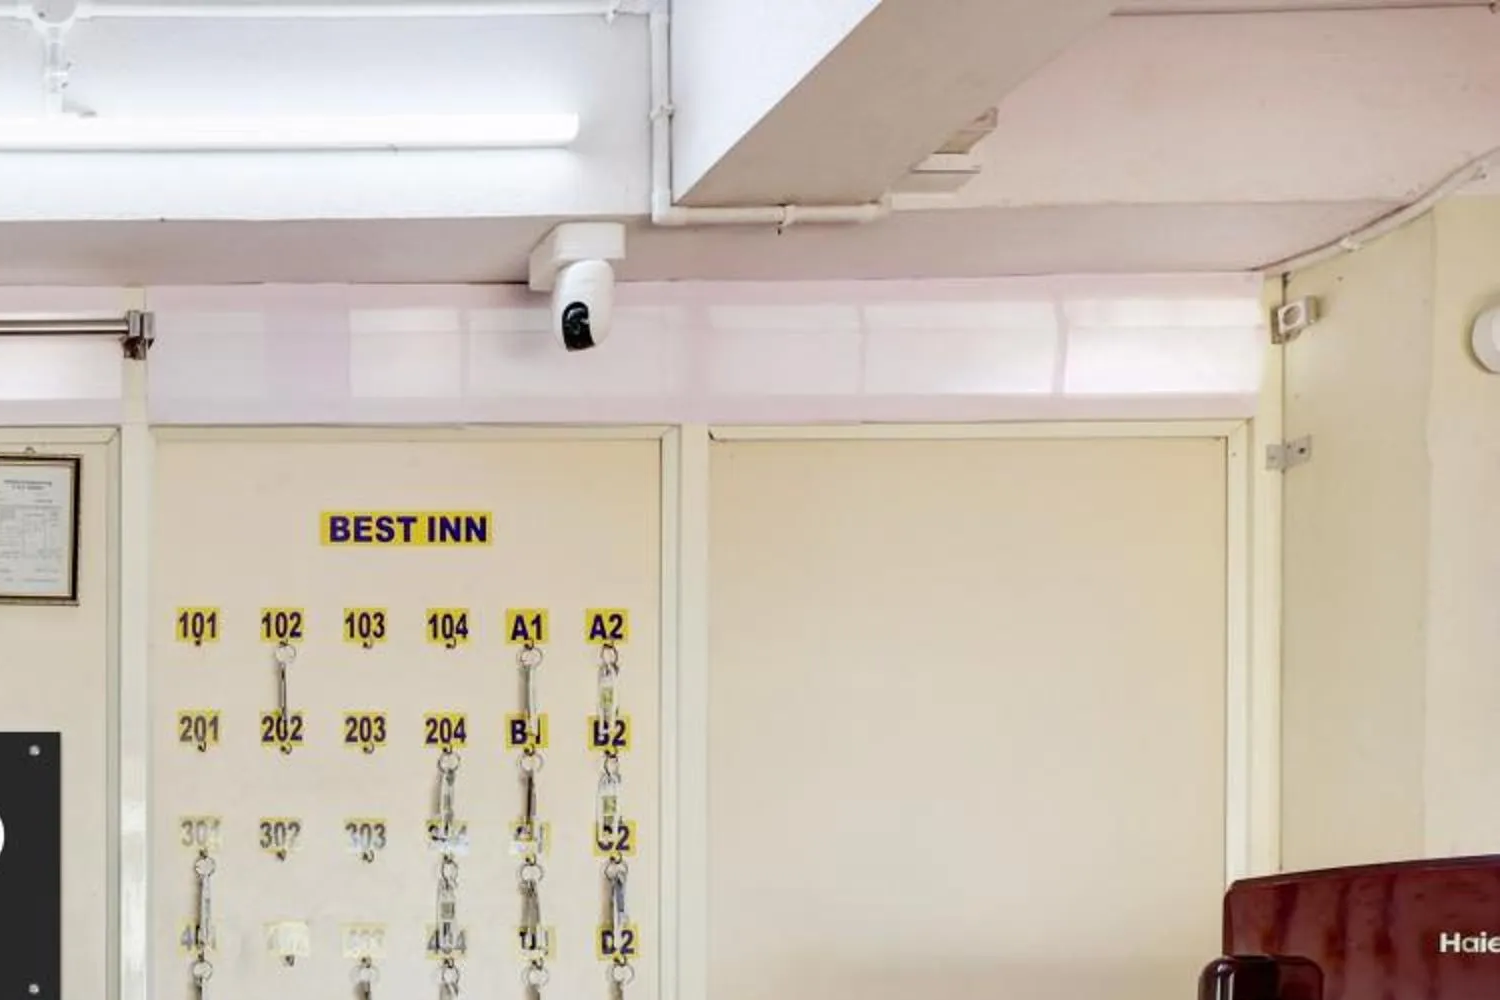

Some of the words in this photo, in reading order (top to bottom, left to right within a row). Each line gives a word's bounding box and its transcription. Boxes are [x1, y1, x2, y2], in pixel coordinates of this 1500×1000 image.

[329, 515, 417, 542] BEST
[427, 516, 487, 542] INN
[179, 612, 217, 638] 101
[261, 612, 302, 638] 102
[345, 612, 386, 638] 103
[428, 613, 469, 639] 104
[511, 613, 542, 640] A1
[589, 613, 623, 640] A2
[179, 716, 219, 742] 201
[261, 716, 303, 742] 202
[344, 716, 386, 742] 203
[425, 718, 467, 744] 204
